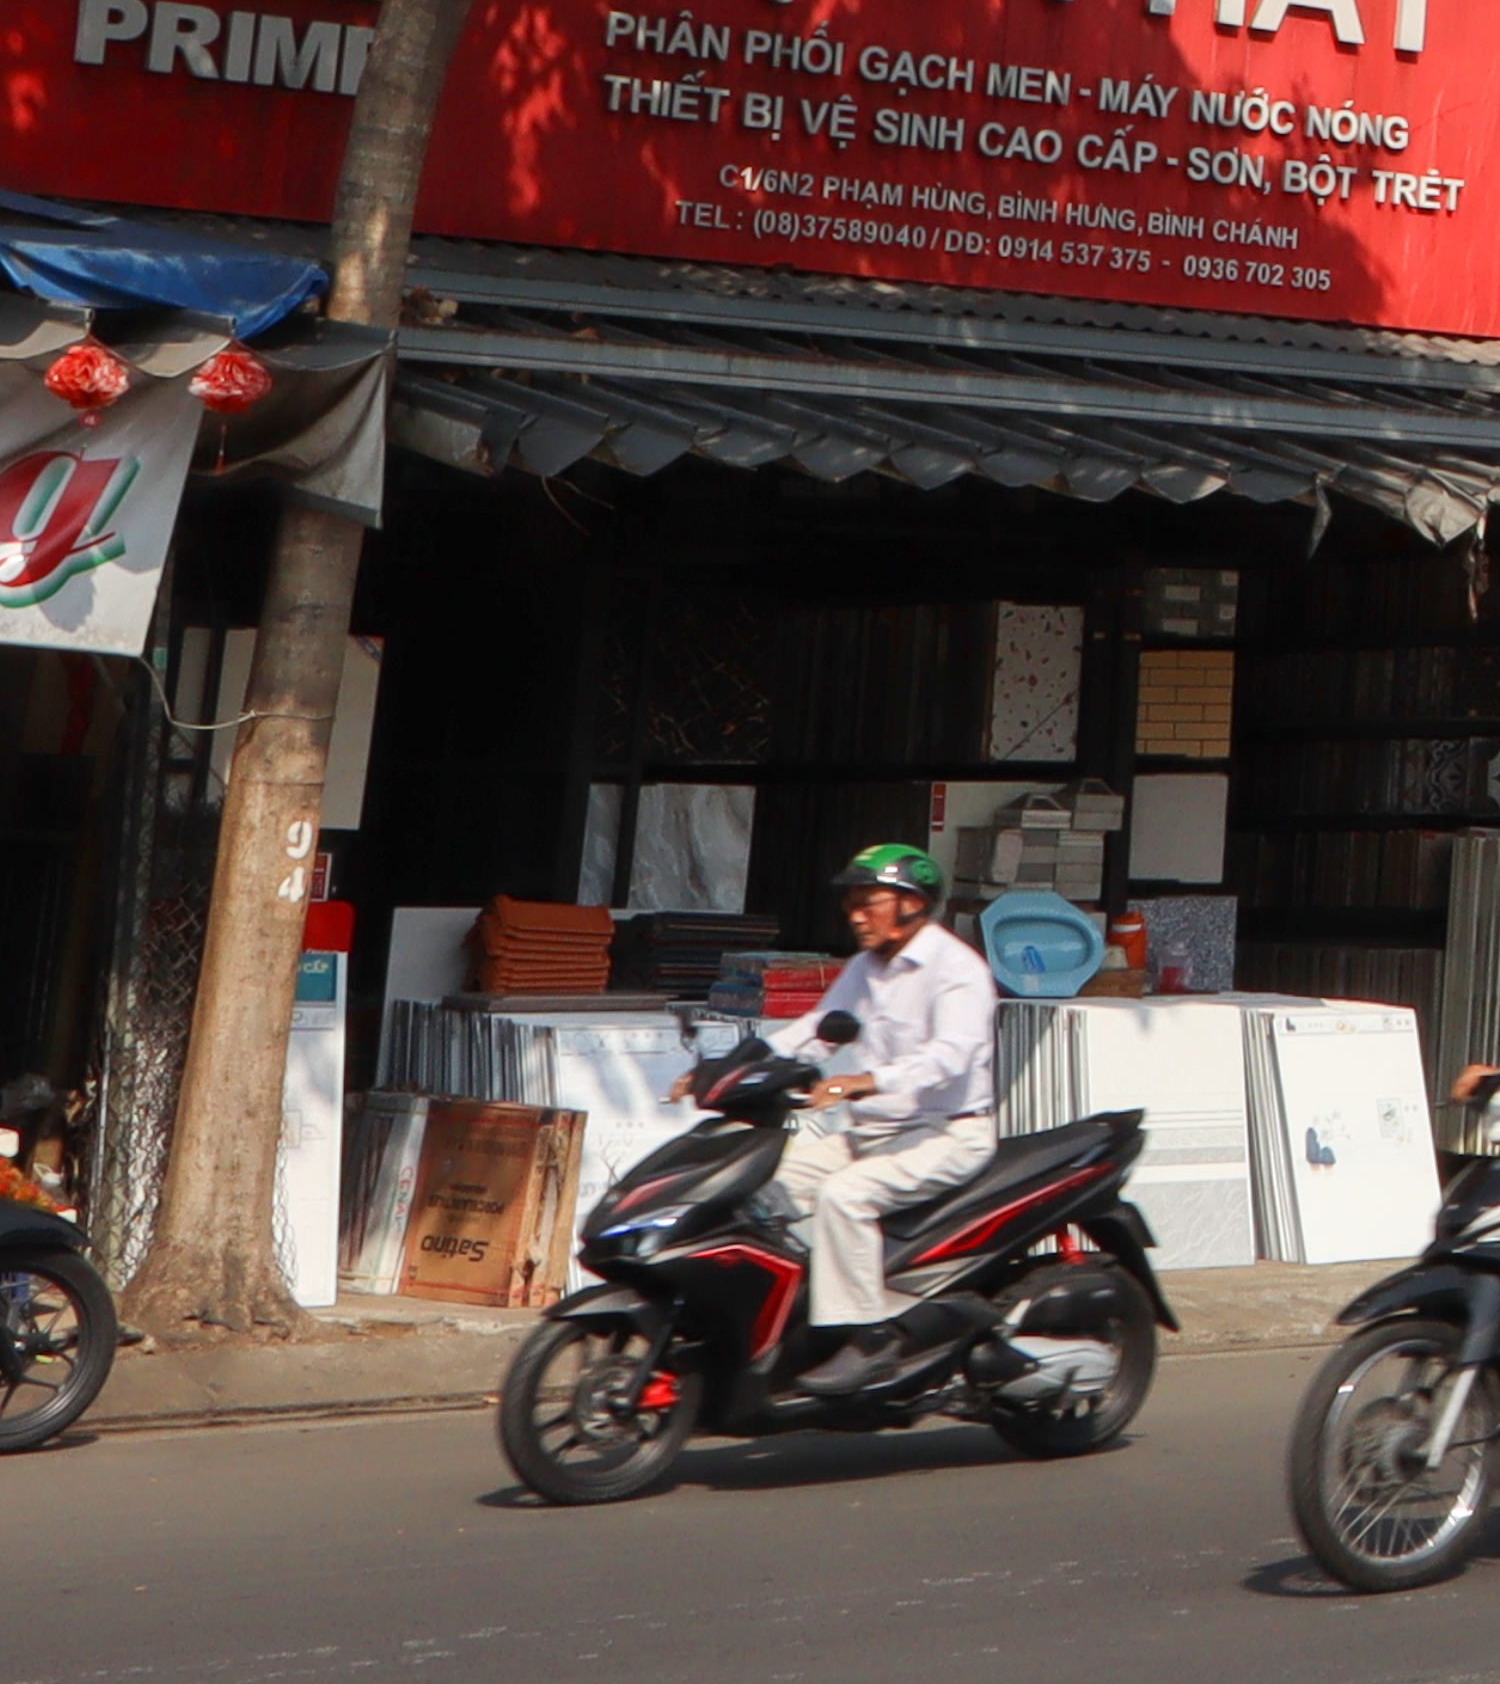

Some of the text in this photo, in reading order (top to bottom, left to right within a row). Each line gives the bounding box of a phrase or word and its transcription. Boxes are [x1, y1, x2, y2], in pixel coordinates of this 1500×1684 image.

[605, 11, 730, 61] PHÂN
[743, 20, 843, 75] PHỐI
[859, 45, 974, 95] GẠCH
[987, 63, 1070, 106] MEN
[1100, 74, 1178, 117] MÁY
[1190, 87, 1296, 136] NƯỚC
[1306, 100, 1409, 150] NÓNG
[604, 70, 730, 123] THIẾT
[743, 93, 783, 141] BỊ
[802, 95, 858, 148] VỆ
[874, 108, 965, 152] SINH
[979, 122, 1062, 163] CAO
[1077, 124, 1158, 174] CẤP
[1187, 146, 1271, 195] SƠN,
[1283, 155, 1357, 205] BỘT
[719, 163, 814, 198] C1/6N2
[822, 176, 903, 209] PHẠM
[999, 189, 1058, 224] BÌNH
[1147, 207, 1204, 240] BÌNH
[1212, 219, 1299, 249] CHÁNH
[753, 208, 927, 249] (08)37589040
[998, 234, 1053, 263] 0914
[1060, 241, 1104, 268] 537
[1108, 246, 1151, 273] 375
[1183, 254, 1239, 282] 0936
[1245, 261, 1284, 287] 702
[1291, 266, 1331, 291] 305
[286, 821, 313, 860] 9
[278, 866, 305, 904] 4
